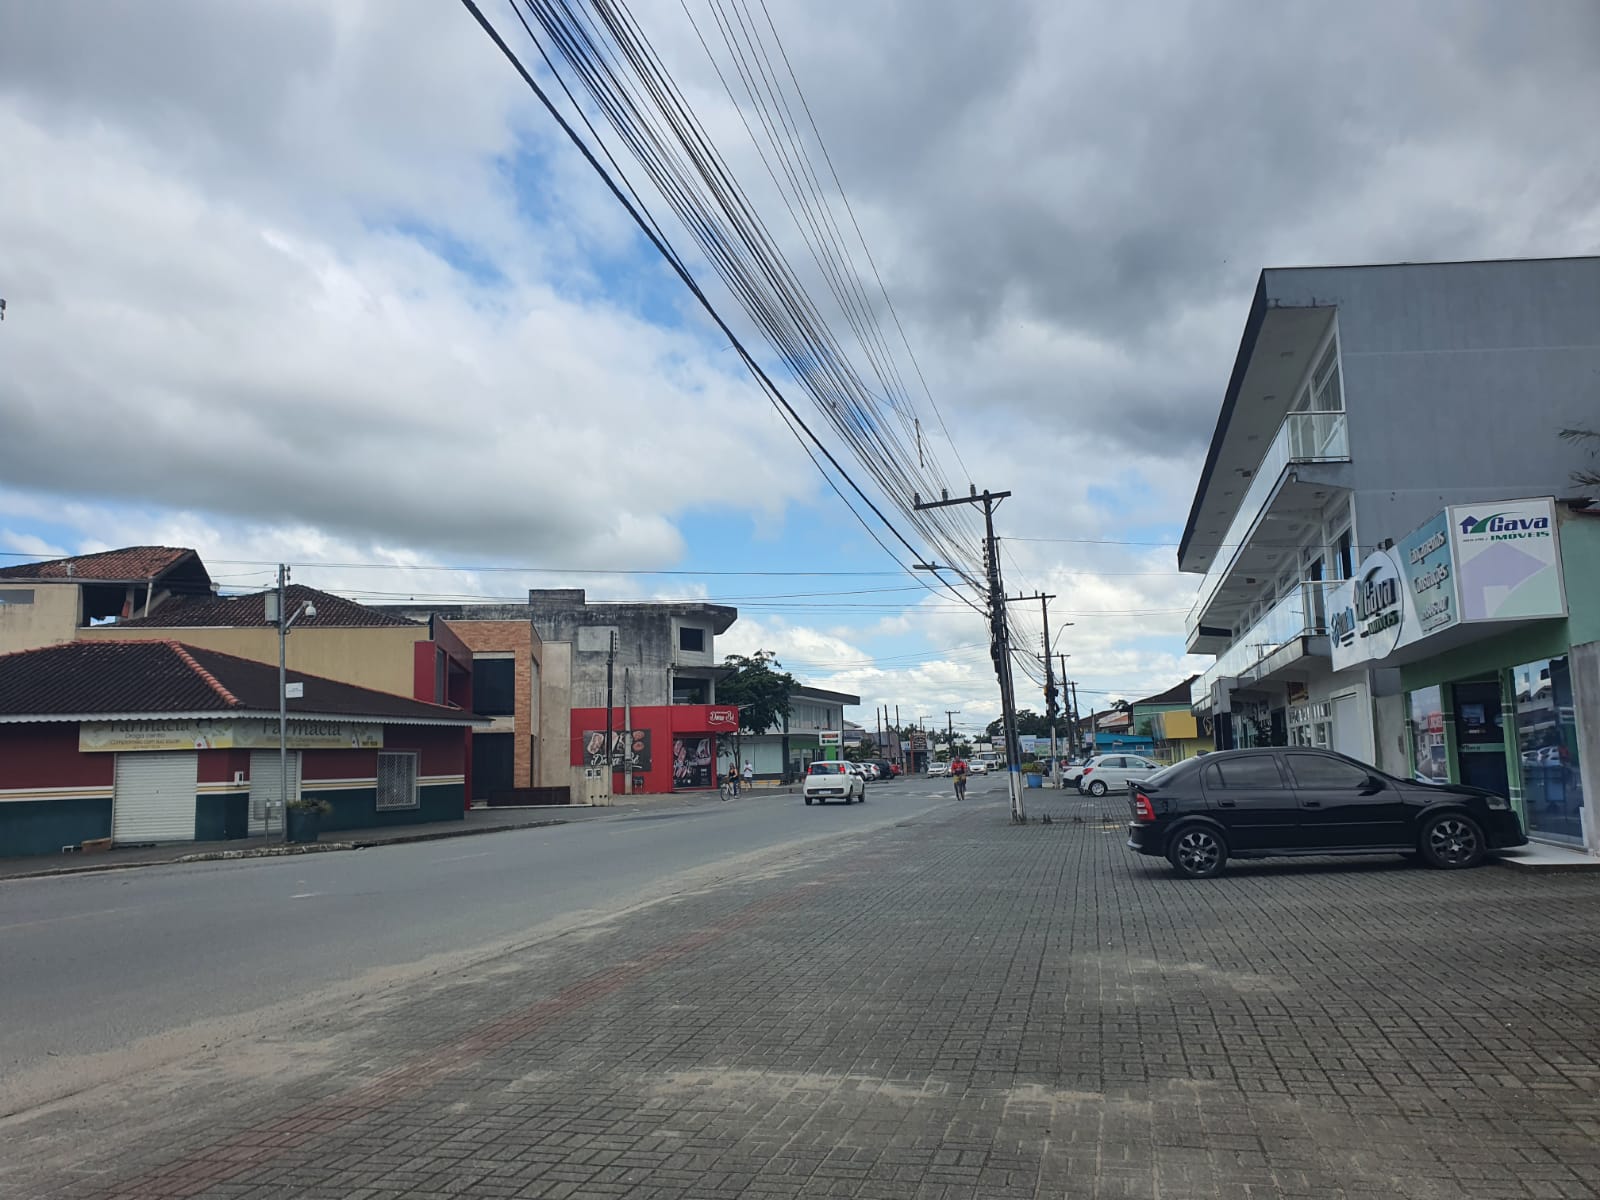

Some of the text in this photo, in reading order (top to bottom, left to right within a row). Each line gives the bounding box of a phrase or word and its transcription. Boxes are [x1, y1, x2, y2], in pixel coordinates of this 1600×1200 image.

[1490, 517, 1548, 532] Gava
[1490, 531, 1550, 541] IMÓVEIS
[1364, 578, 1396, 616] Gava
